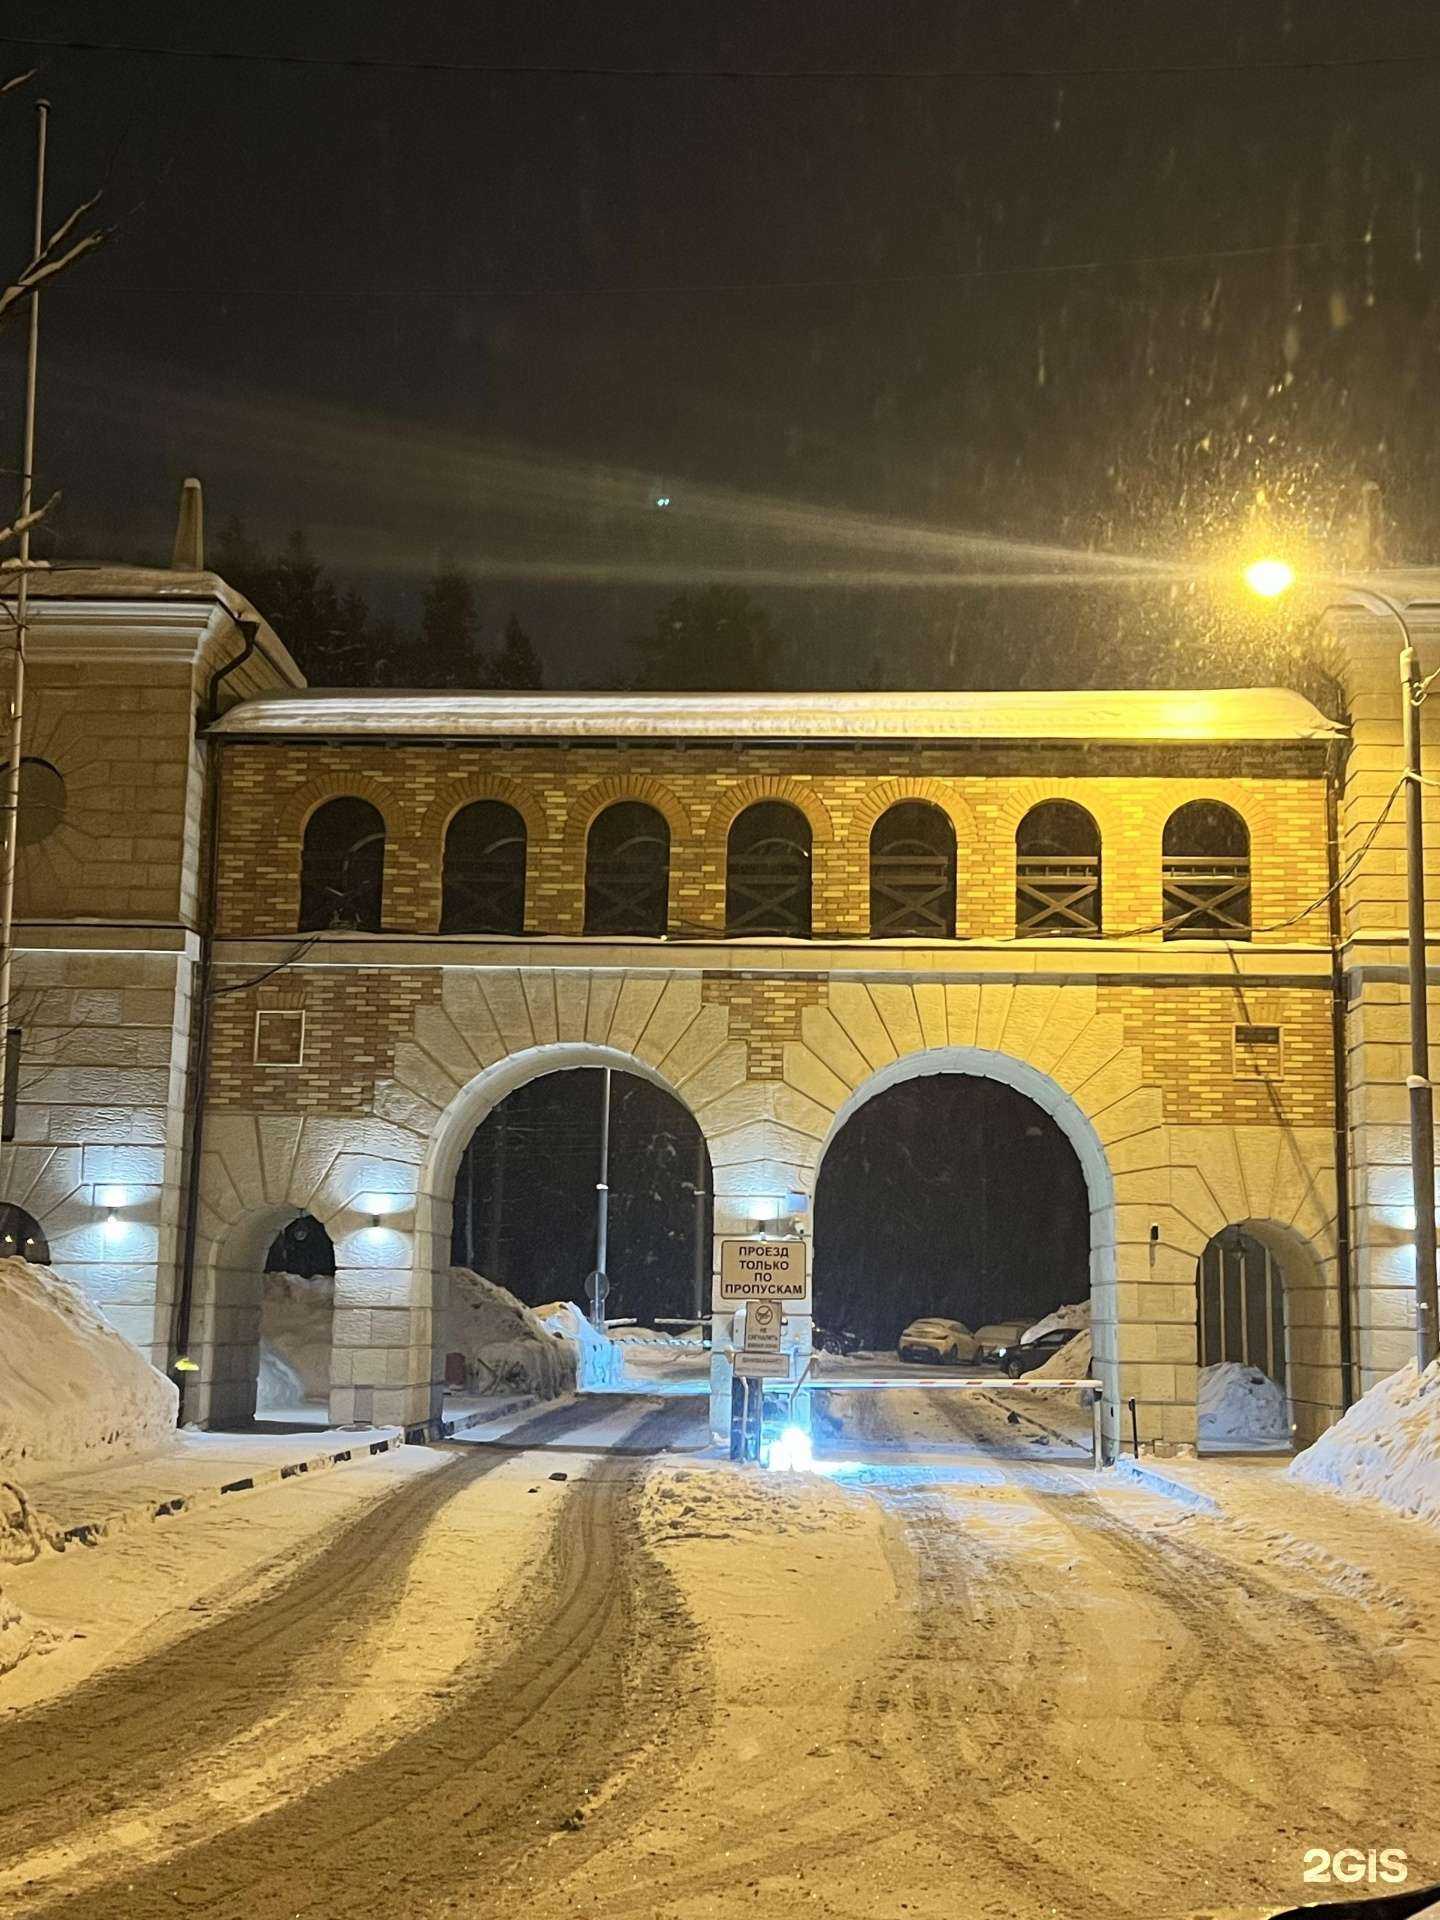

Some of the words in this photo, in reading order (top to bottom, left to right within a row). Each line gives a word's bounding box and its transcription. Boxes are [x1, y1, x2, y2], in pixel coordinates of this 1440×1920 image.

[739, 1247, 789, 1258] ПРОЕЗД
[739, 1260, 789, 1270] ТОЛЬКО
[754, 1273, 772, 1282] ПО
[725, 1284, 802, 1294] ПРОПУСКАМ
